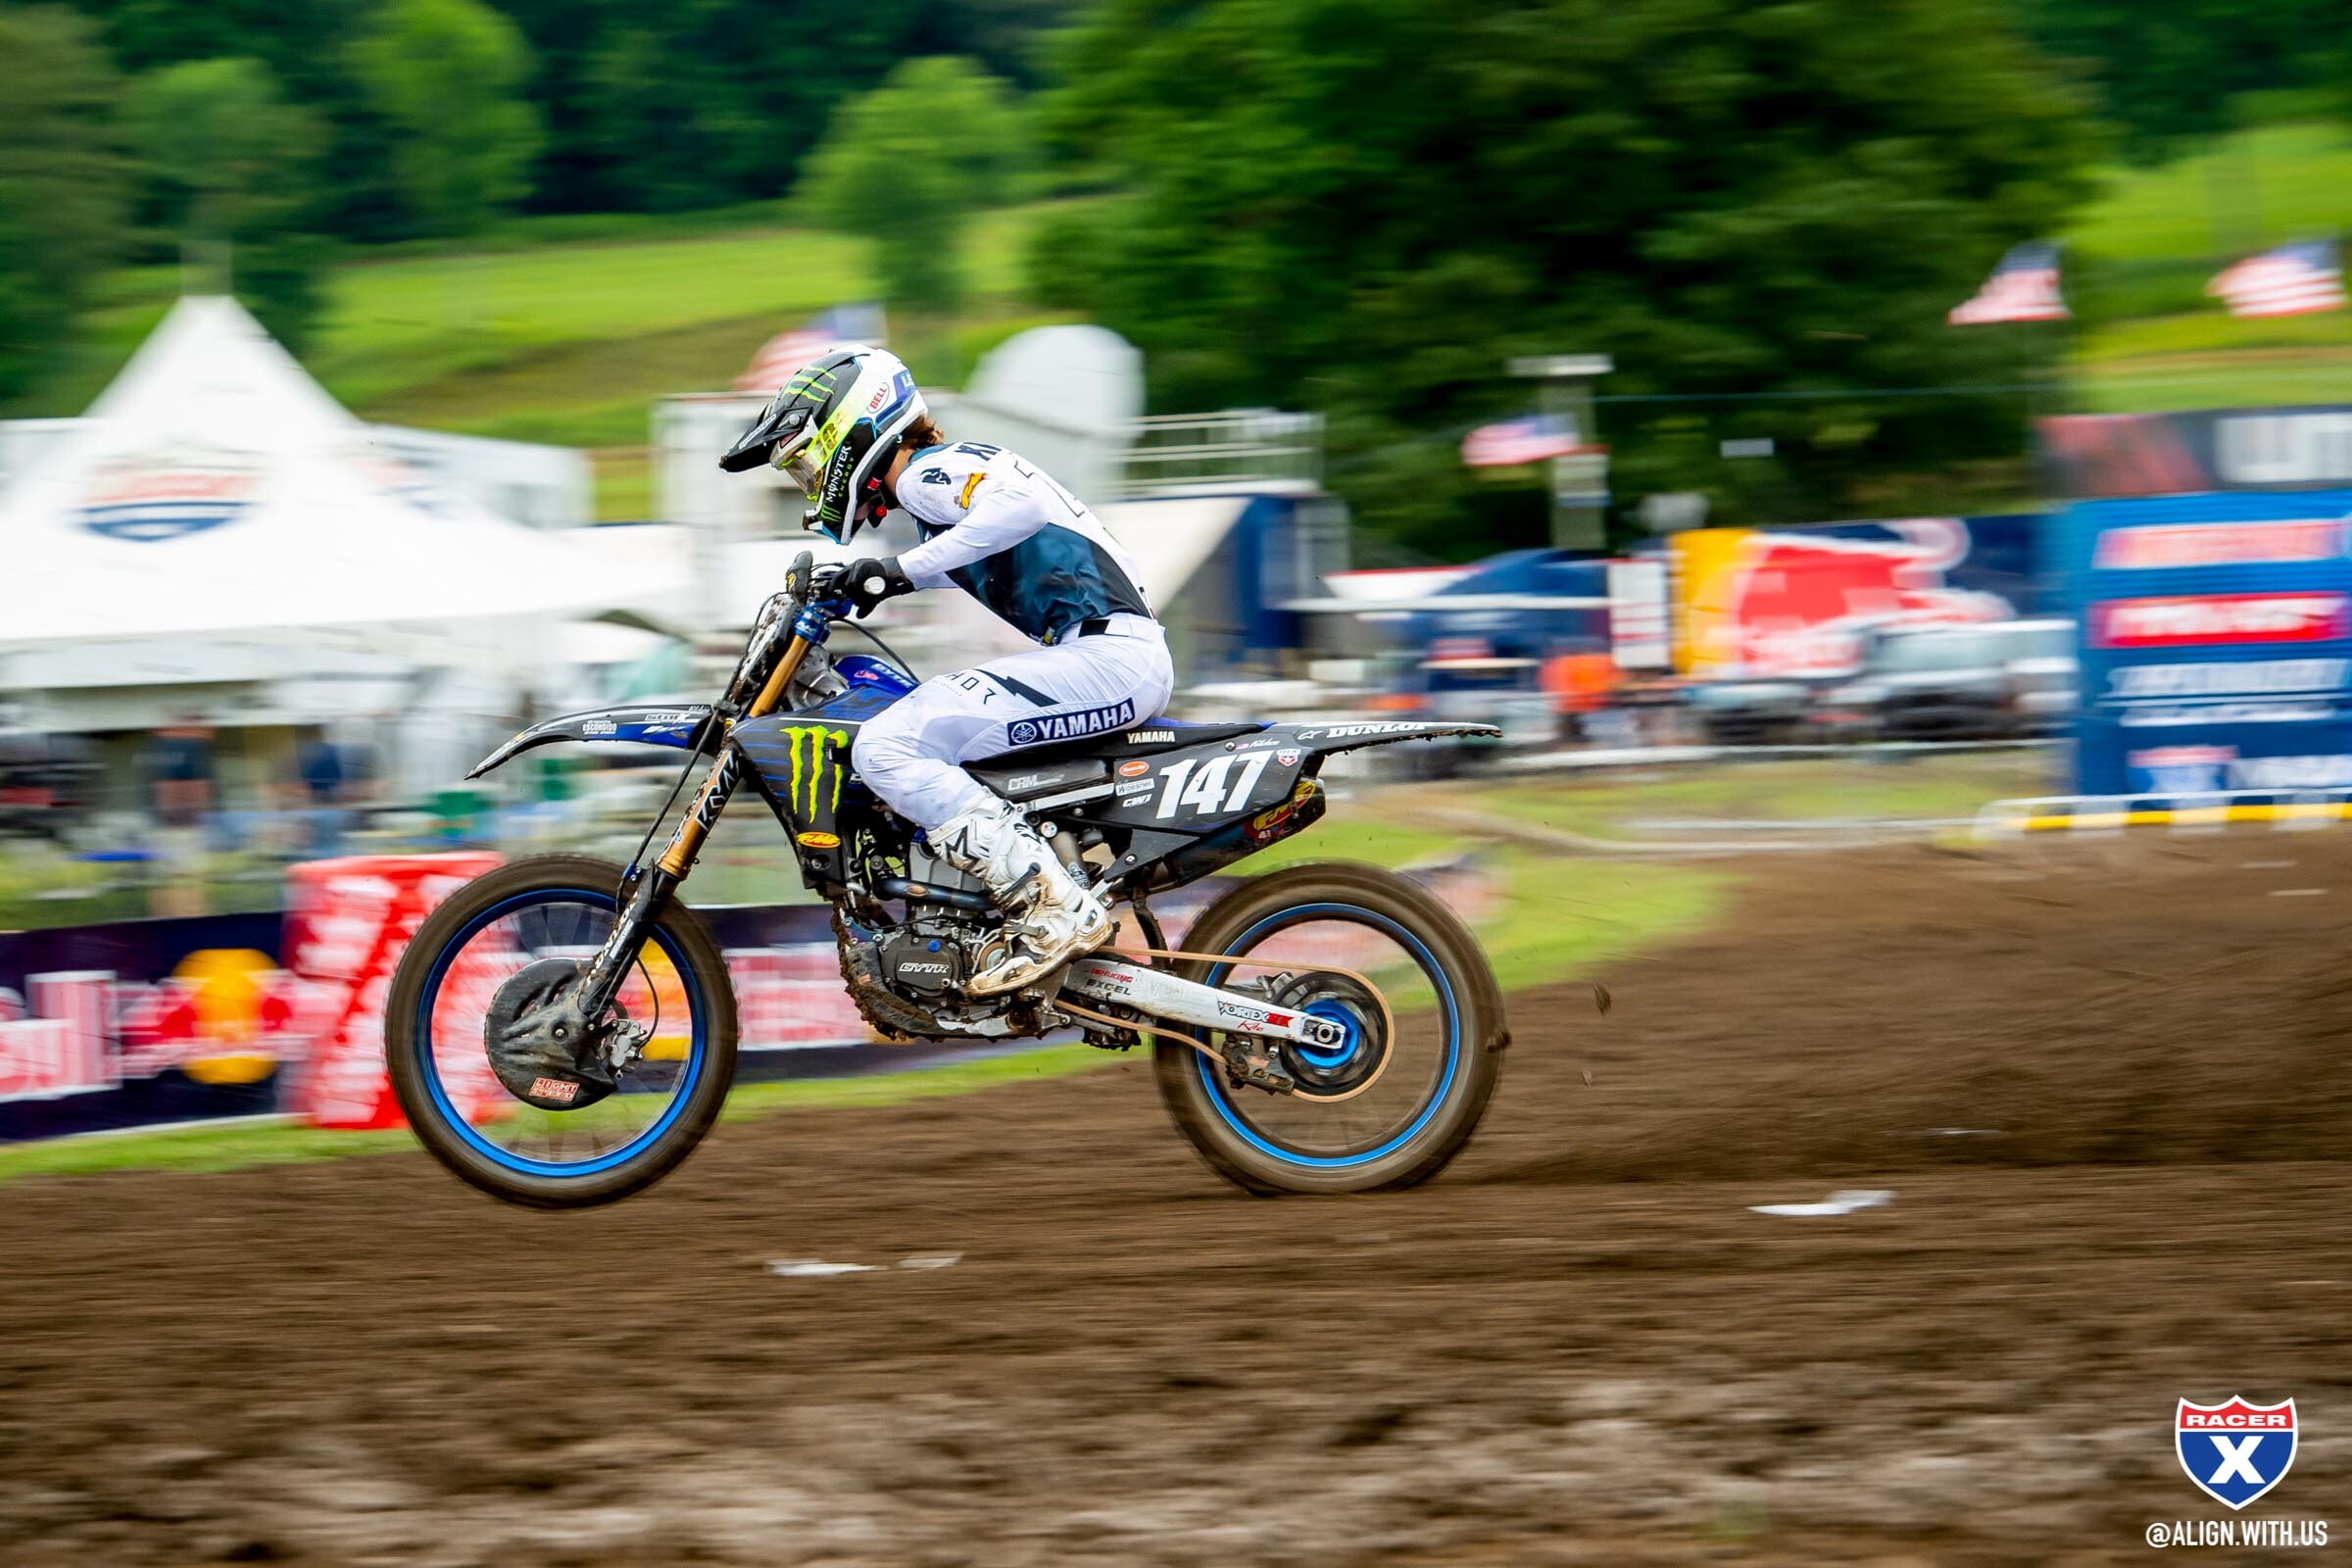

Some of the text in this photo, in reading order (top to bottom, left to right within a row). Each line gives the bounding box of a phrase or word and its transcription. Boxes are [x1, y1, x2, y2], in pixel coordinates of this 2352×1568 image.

[869, 386, 887, 413] BELL
[826, 444, 853, 503] MONSTER
[838, 457, 855, 498] ENERGY
[1038, 703, 1134, 740] YAMAHA
[1127, 731, 1175, 745] YAMAHA
[1155, 750, 1275, 819] 147
[899, 962, 950, 974] GYTR
[1086, 979, 1132, 997] EXCEL
[1216, 996, 1270, 1022] VORTEX
[535, 1078, 579, 1092] LIGHT
